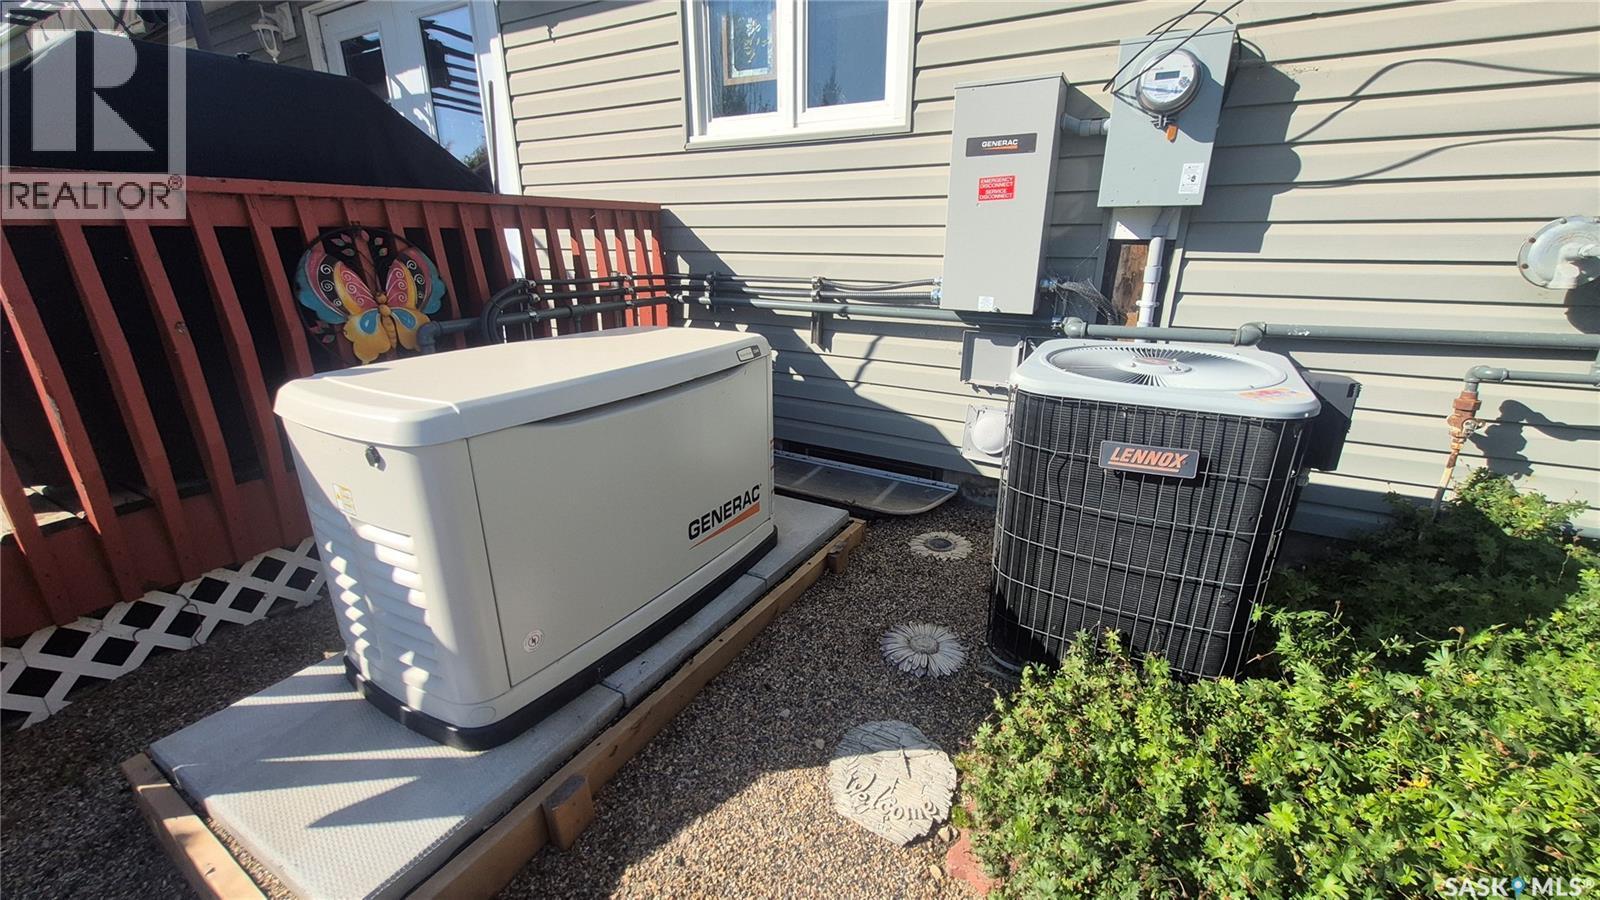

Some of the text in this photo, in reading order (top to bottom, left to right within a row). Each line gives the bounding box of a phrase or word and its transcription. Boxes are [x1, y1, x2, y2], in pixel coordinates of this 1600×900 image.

[981, 139, 1019, 148] GENERAC
[1110, 447, 1190, 469] LENNOX
[688, 484, 761, 540] GENERAC
[845, 769, 940, 822] Welcome
